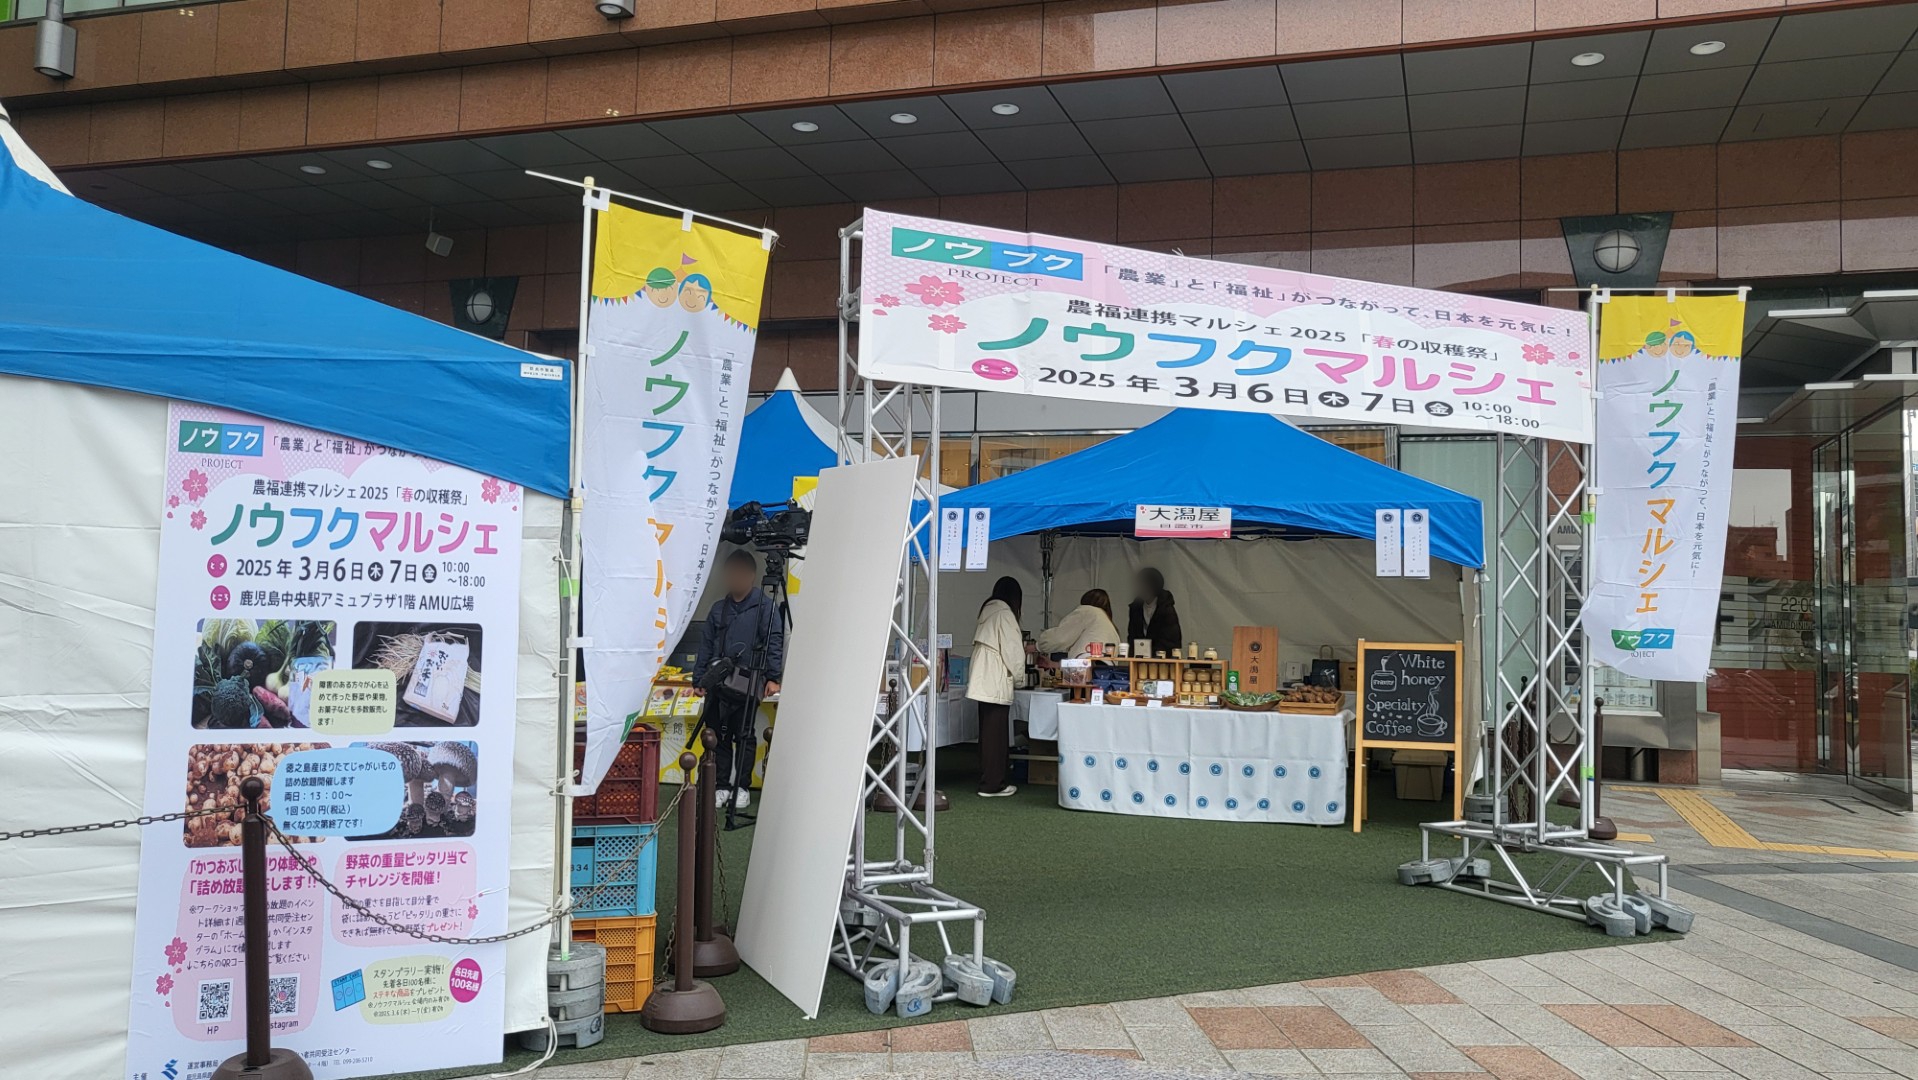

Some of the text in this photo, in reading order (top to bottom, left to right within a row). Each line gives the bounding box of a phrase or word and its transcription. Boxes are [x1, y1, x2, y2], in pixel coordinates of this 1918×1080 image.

[948, 268, 1043, 287] PROJECT
[977, 317, 1557, 406] ノウフクマルシェ
[979, 363, 1014, 376] とき
[1461, 400, 1512, 414] 10:00
[201, 457, 244, 470] PROJECT
[1636, 369, 1684, 614] ノウフクマルシェ
[1149, 506, 1221, 522] 大潟屋
[211, 502, 498, 555] ノウフクマルシェ
[210, 561, 225, 571] とき
[442, 561, 470, 573] 10:00
[1398, 653, 1446, 669] White
[1631, 650, 1657, 659] OJECT
[1249, 655, 1259, 685] 大潟屋
[1400, 669, 1446, 689] honey
[1365, 692, 1427, 715] Specialty
[1365, 720, 1413, 737] Coffee
[284, 776, 356, 788] 詰め放題開催します
[345, 850, 468, 870] 野菜の重量ピッタリ当て
[345, 871, 441, 889] チャレンジを開催!
[451, 977, 480, 992] 100名様
[207, 1026, 220, 1035] HP
